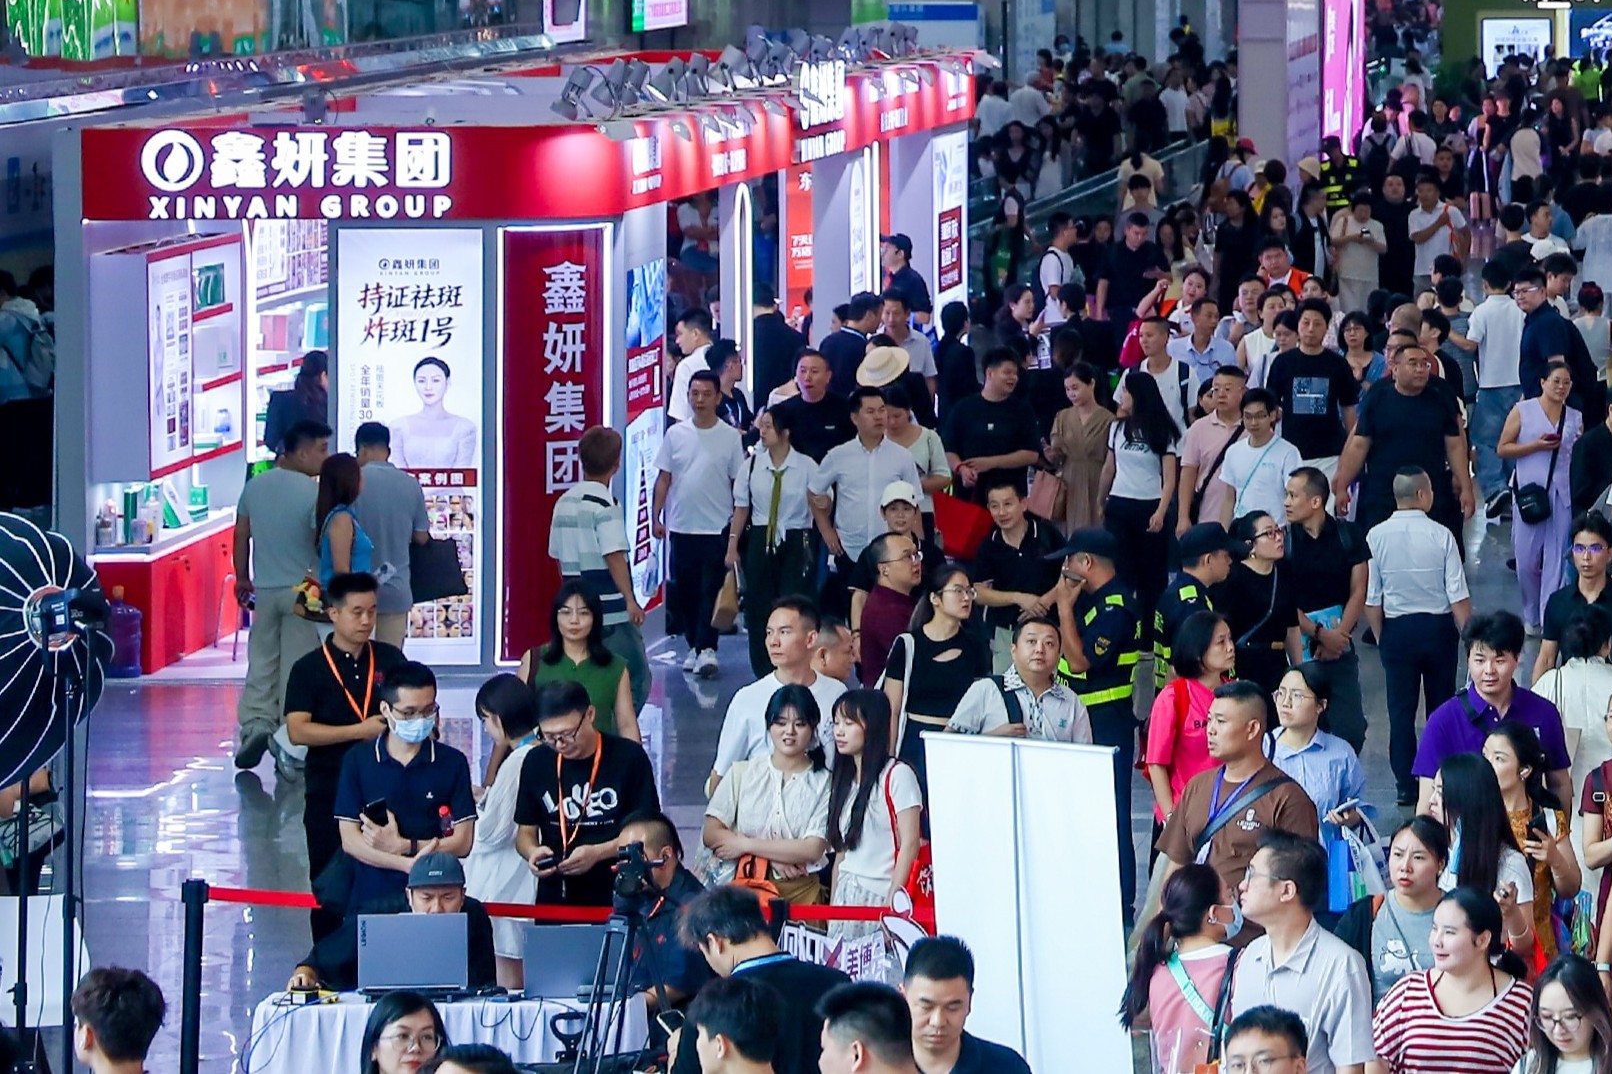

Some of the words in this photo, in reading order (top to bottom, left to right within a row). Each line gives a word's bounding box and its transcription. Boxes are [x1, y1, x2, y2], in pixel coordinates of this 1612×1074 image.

[210, 130, 452, 189] 鑫妍集团
[150, 197, 297, 219] XINYAN
[320, 196, 453, 219] GROUP
[358, 282, 463, 315] 持证祛斑
[364, 317, 457, 349] 炸斑1号
[543, 261, 586, 495] 鑫妍集团
